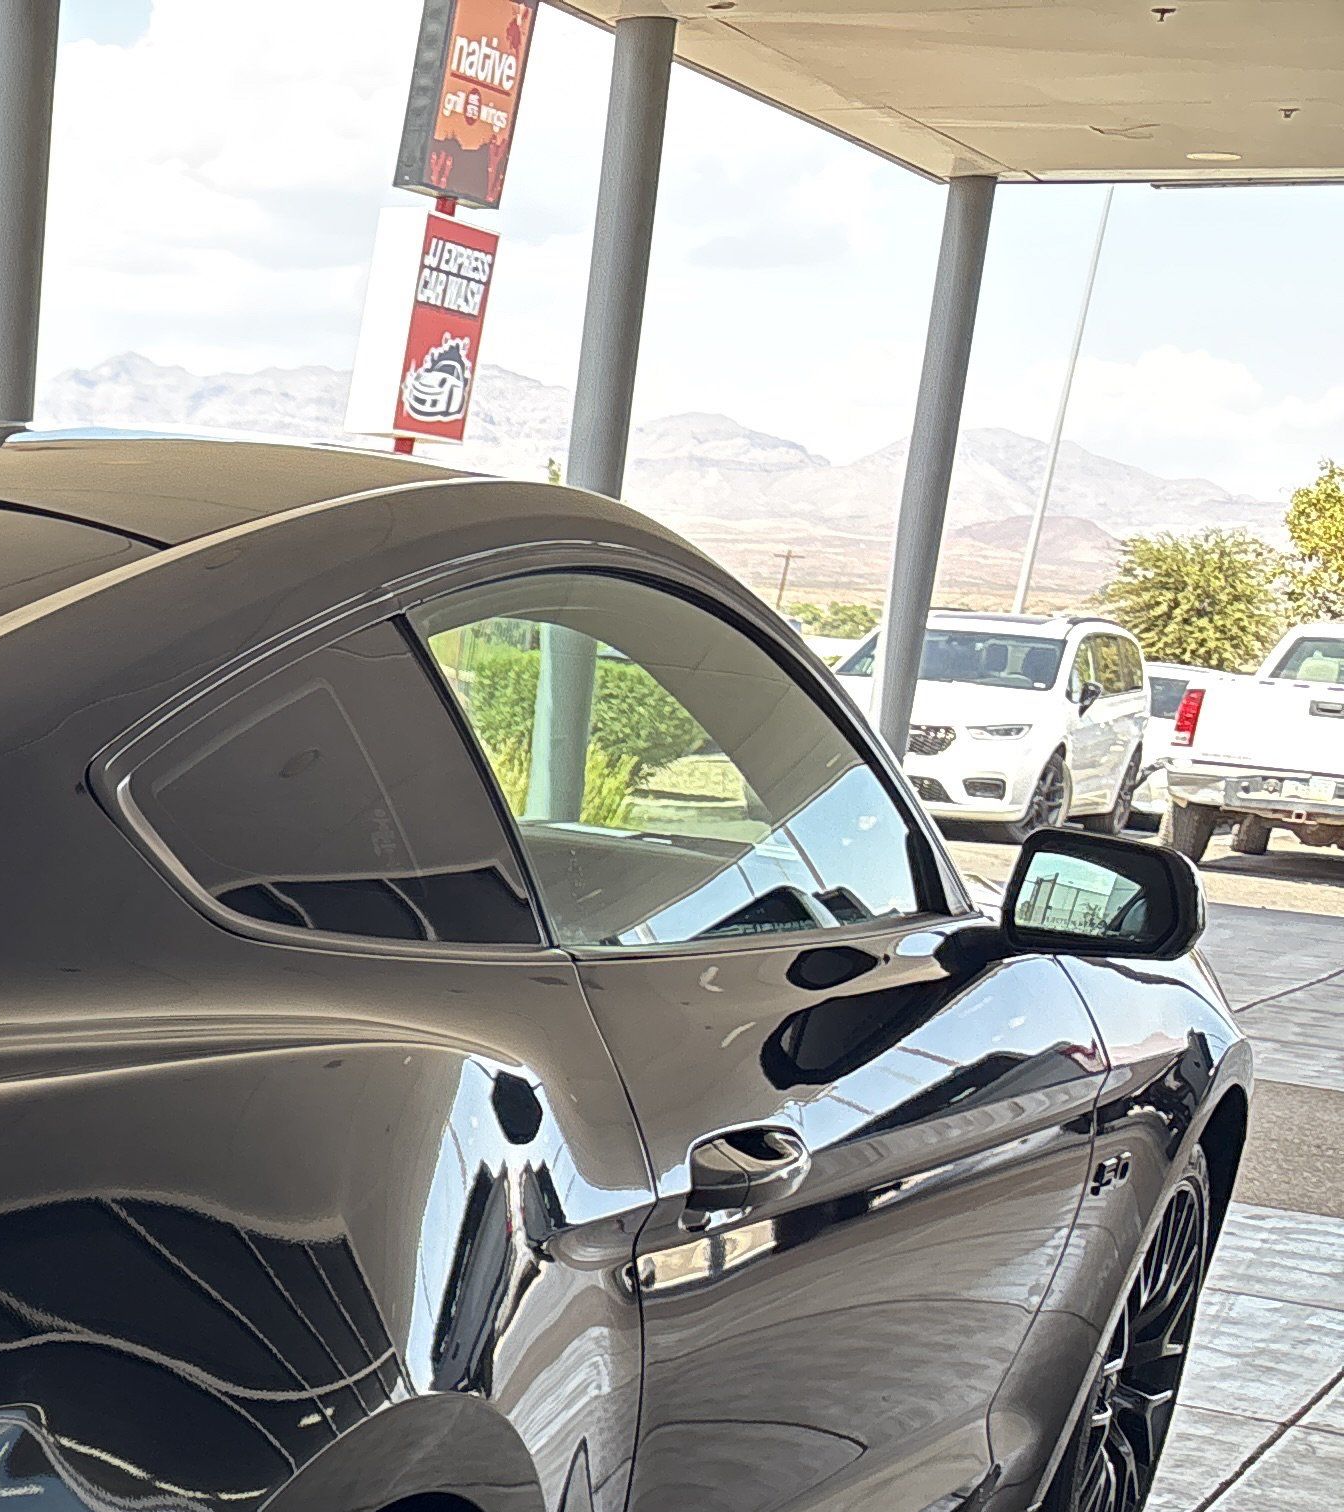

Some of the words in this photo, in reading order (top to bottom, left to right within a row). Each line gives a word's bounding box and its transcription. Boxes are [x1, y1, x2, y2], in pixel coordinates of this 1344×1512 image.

[451, 35, 517, 90] native
[439, 242, 492, 282] EXPRESS
[417, 268, 447, 306] CAR
[443, 275, 485, 316] WASH
